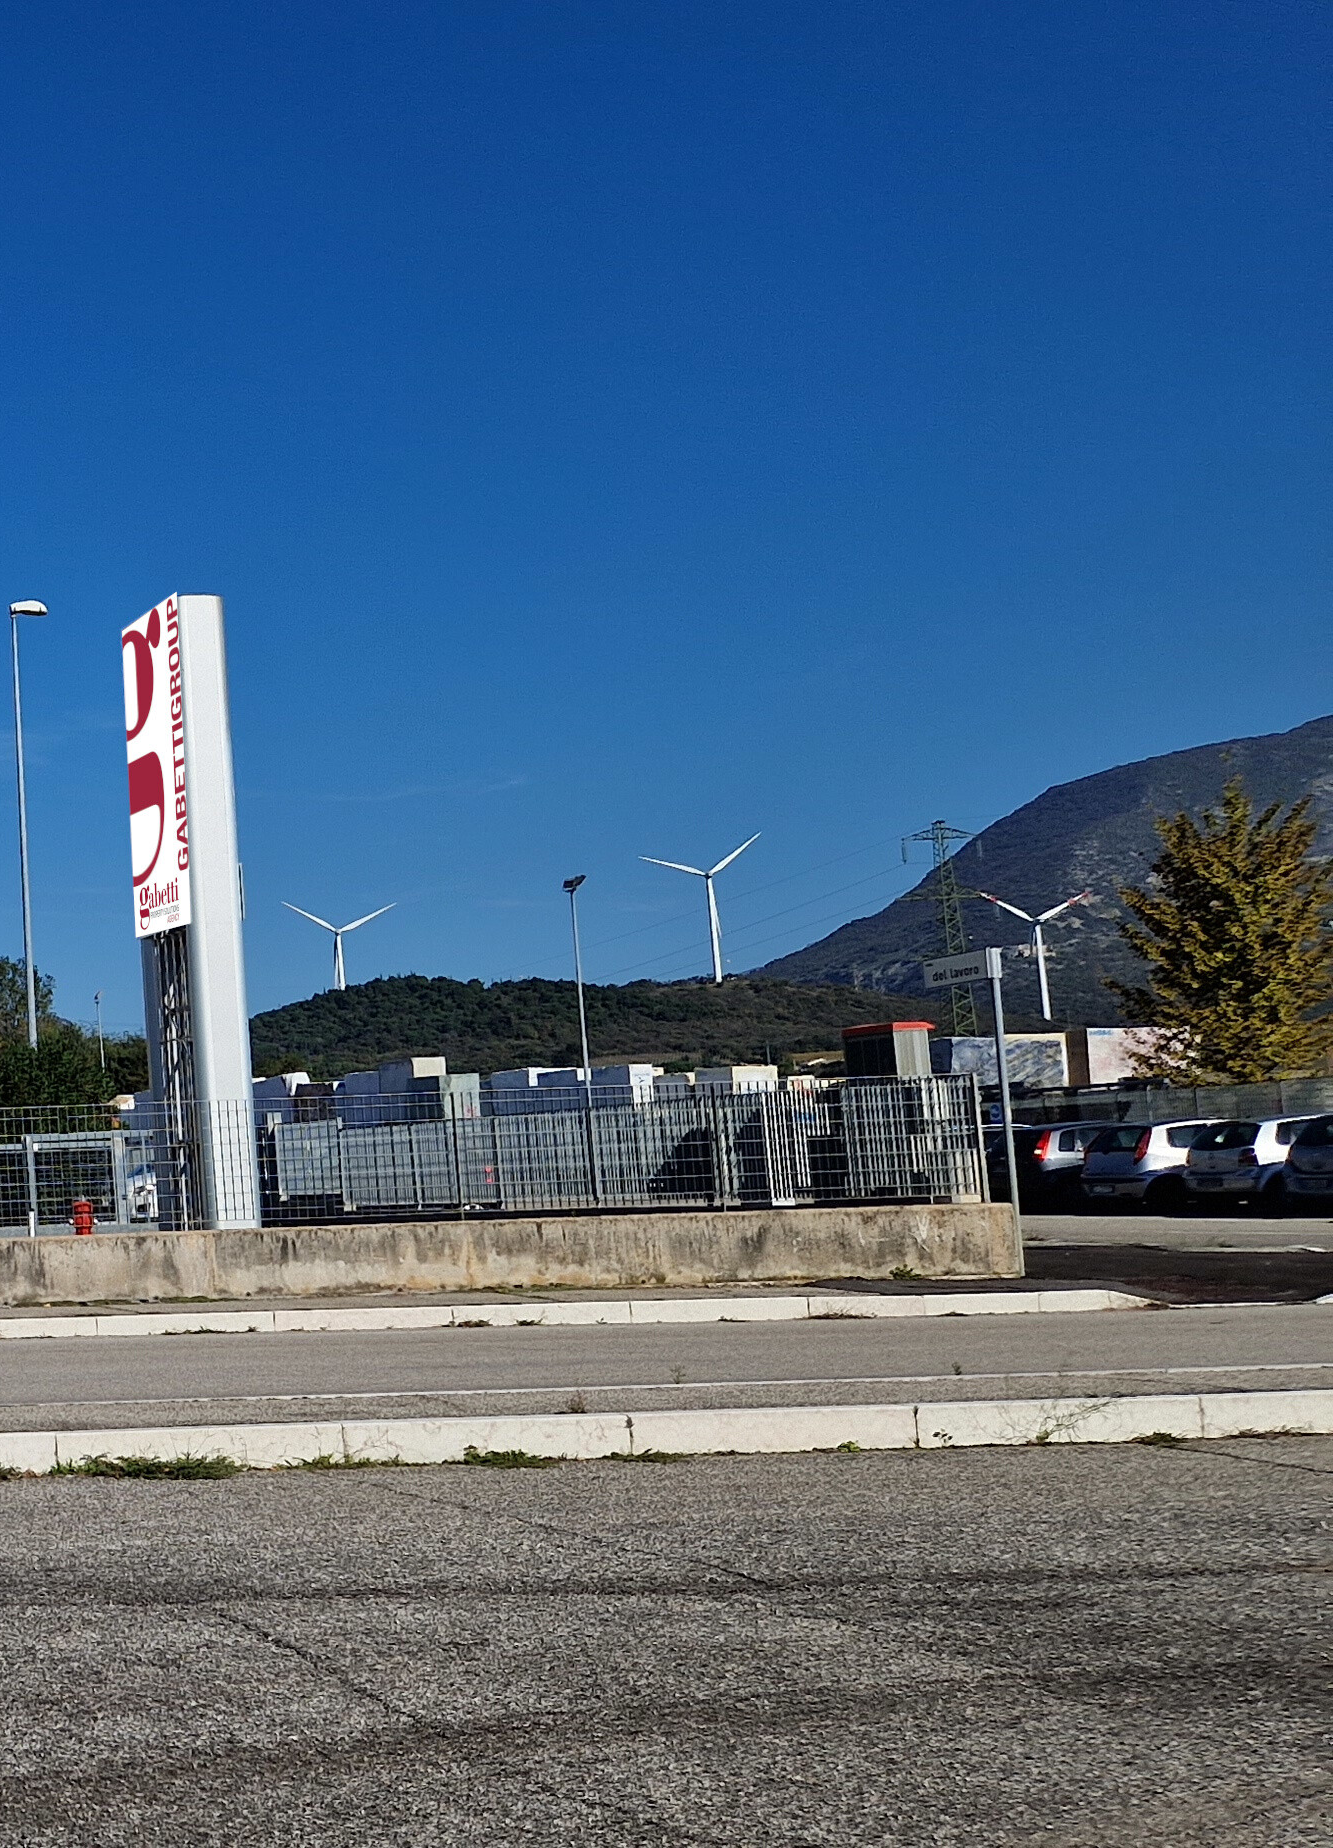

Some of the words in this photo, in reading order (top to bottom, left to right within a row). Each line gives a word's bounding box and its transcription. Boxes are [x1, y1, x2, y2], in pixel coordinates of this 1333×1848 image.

[166, 598, 189, 871] GABETTIGROUP
[139, 877, 179, 930] gabetti
[932, 970, 947, 981] del
